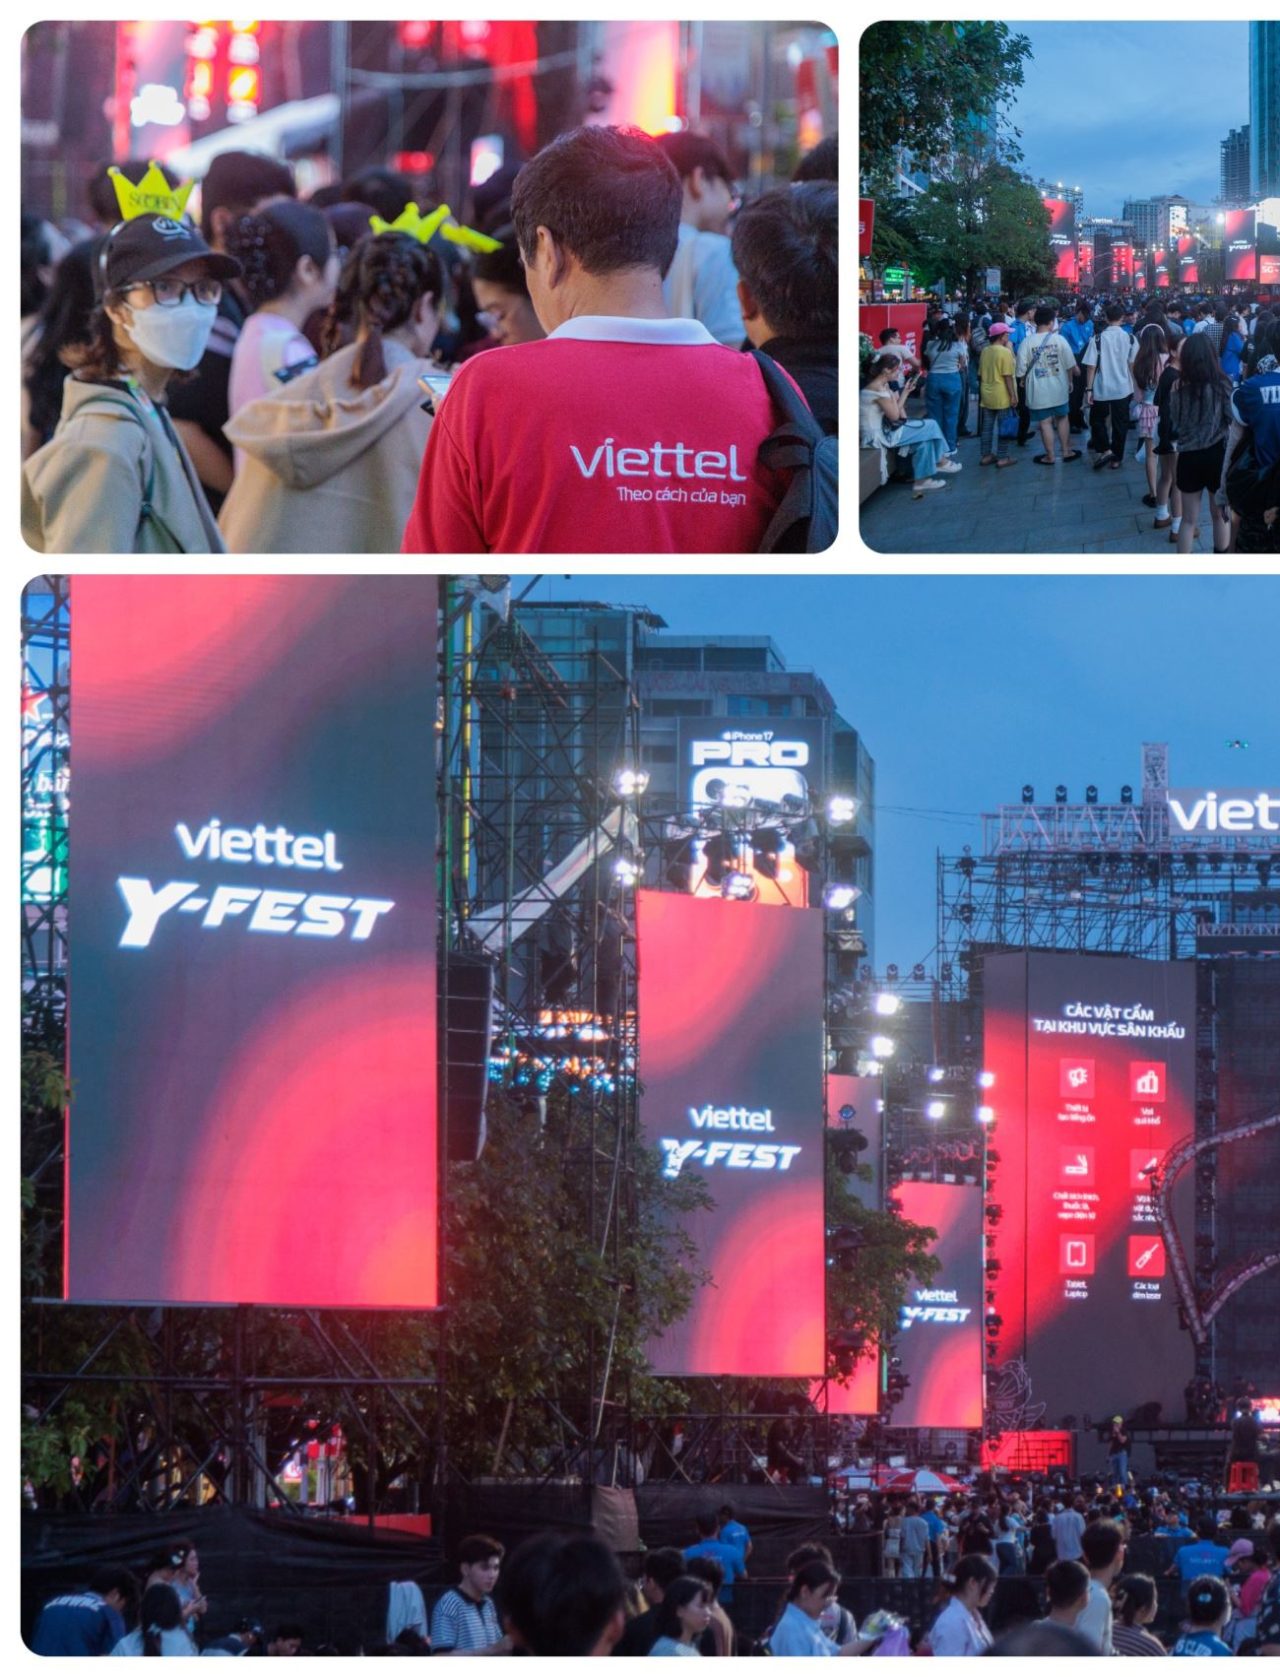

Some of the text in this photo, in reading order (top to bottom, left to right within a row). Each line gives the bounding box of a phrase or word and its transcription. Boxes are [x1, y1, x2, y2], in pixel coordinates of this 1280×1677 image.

[569, 437, 747, 481] viettel
[616, 486, 746, 508] Theo cách của bạn
[732, 731, 763, 741] iPhone
[692, 741, 809, 766] PRO
[175, 818, 344, 871] viettel
[117, 875, 396, 949] Y-FEST
[1065, 1002, 1154, 1021] CÁC VẬT CẤM
[1034, 1019, 1057, 1034] TẠI
[1058, 1020, 1086, 1034] KHU
[1117, 1023, 1146, 1037] SÂN
[689, 1104, 776, 1132] viettel
[661, 1138, 802, 1178] Y-FEST
[916, 1289, 958, 1303] viettel
[902, 1306, 971, 1328] Y-FEST
